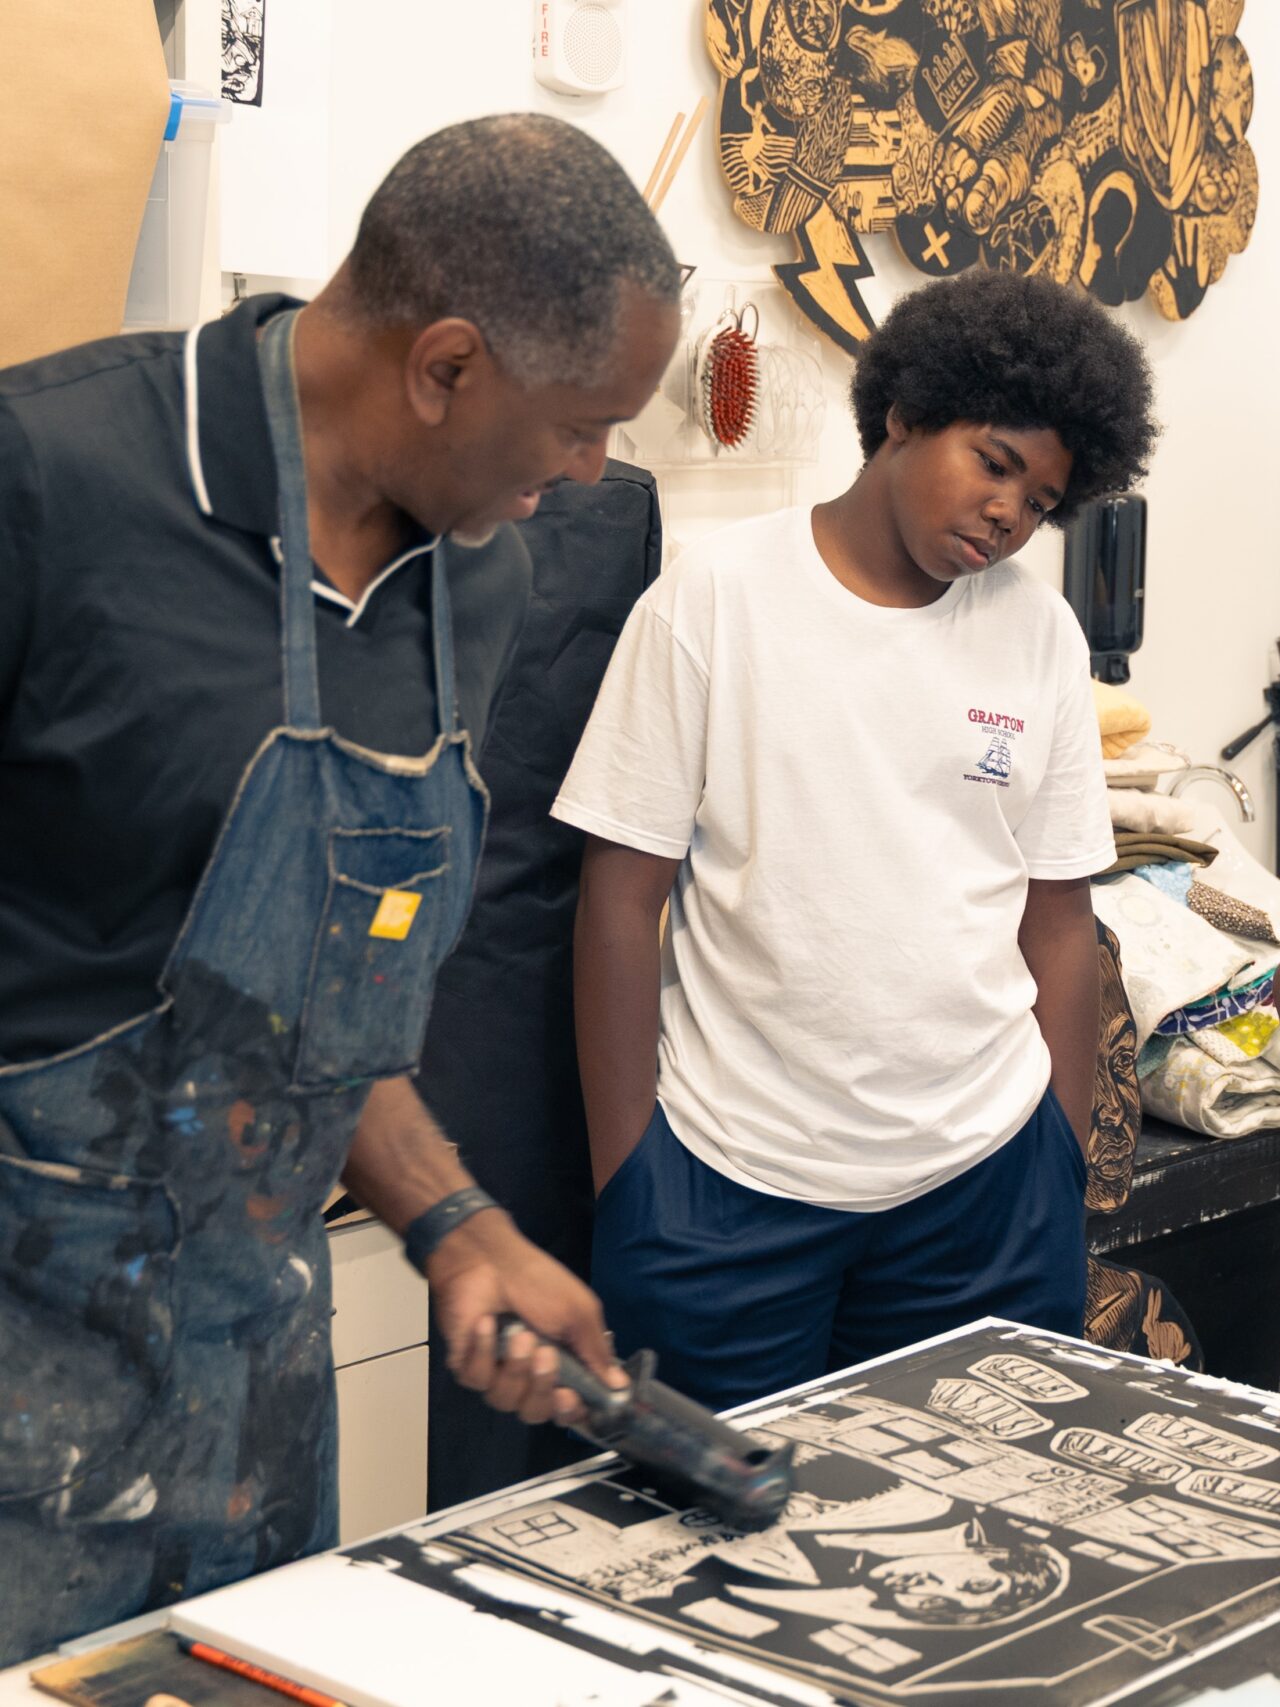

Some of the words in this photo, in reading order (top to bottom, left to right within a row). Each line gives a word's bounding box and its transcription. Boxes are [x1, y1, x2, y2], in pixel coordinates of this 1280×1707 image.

[540, 3, 549, 57] FIRE
[938, 66, 974, 110] QUEEN
[967, 708, 1025, 733] GRAFTON
